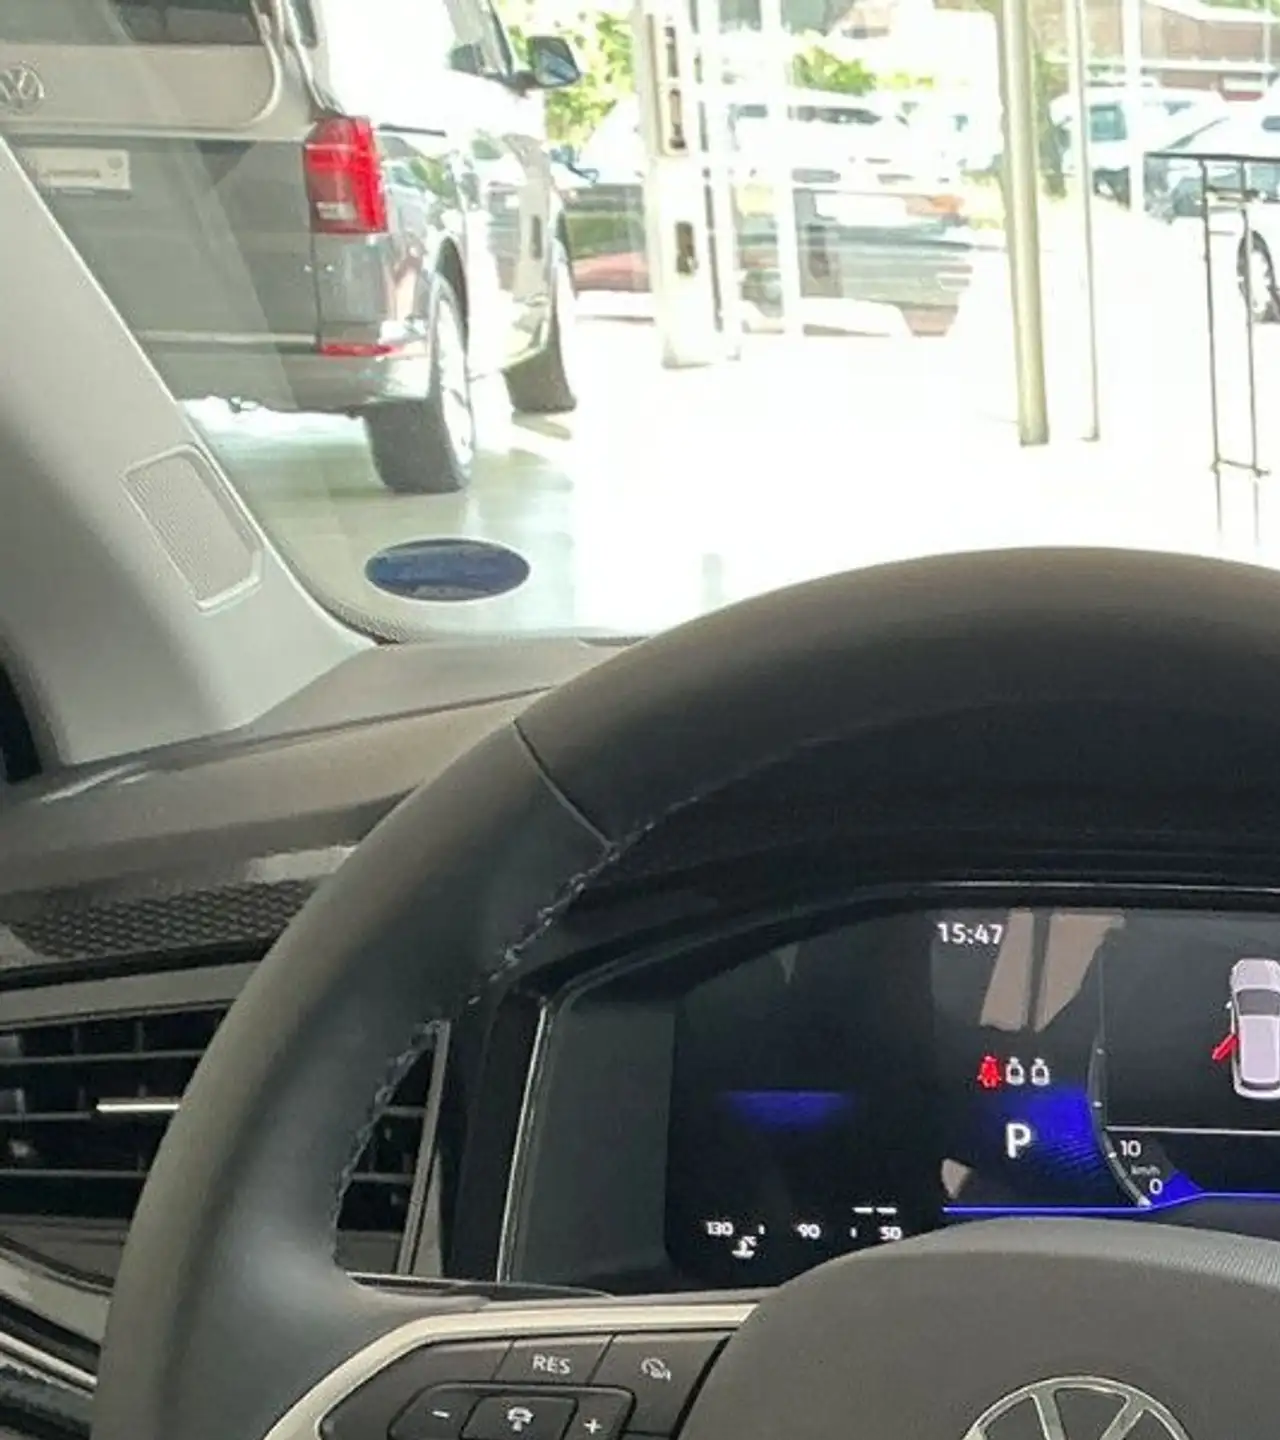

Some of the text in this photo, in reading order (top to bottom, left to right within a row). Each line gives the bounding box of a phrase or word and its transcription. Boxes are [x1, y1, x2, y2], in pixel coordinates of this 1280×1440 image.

[938, 923, 1003, 945] 15:47
[1005, 1123, 1031, 1158] P
[1120, 1139, 1142, 1158] 10
[1149, 1178, 1164, 1196] 0
[706, 1221, 734, 1236] 130
[797, 1223, 821, 1239] 90
[880, 1226, 903, 1240] 50
[532, 1354, 571, 1375] RES
